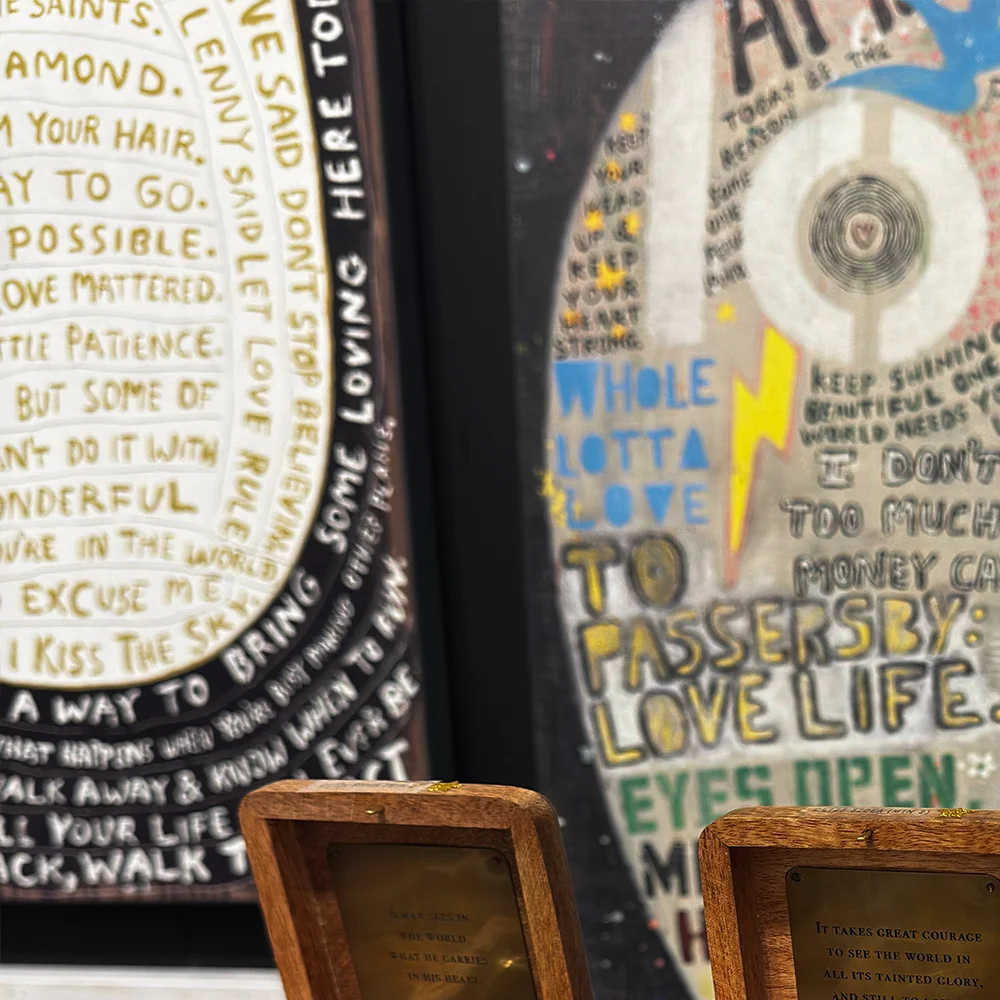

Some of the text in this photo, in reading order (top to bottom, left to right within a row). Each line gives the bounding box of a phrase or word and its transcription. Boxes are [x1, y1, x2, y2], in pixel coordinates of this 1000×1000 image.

[28, 111, 206, 166] YOUR HAIR.
[56, 169, 208, 212] TO GO.
[7, 225, 218, 259] POSSIBLE.
[66, 322, 222, 361] PATIENCE.
[316, 94, 375, 554] SOME LOVING HERE
[15, 380, 220, 422] BUT SOME OF
[554, 357, 717, 420] WHOLE
[66, 435, 219, 468] DO IT WITH
[555, 427, 710, 478] LOTTA
[817, 449, 854, 488] I
[564, 482, 708, 531] LOVE
[779, 498, 864, 538] TOO
[122, 529, 174, 561] THE
[561, 531, 688, 616] TO
[793, 550, 937, 595] MONEY
[21, 575, 222, 618] EXCUSE ME
[9, 566, 322, 726] A WAY TO BRING
[9, 633, 174, 676] I KISS THE
[577, 592, 988, 696] PASSERSBY:
[592, 667, 779, 767] LOVE
[48, 806, 232, 846] YOUR LIFE
[88, 845, 211, 887] WALK
[401, 932, 466, 943] THE WORLD
[457, 914, 468, 922] IN
[833, 926, 872, 936] TAKES
[877, 928, 918, 939] GREAT
[922, 931, 982, 942] COURAGE
[425, 954, 439, 962] HE
[443, 955, 488, 965] CARRIES
[827, 948, 970, 964] TO SEE THE WORLD IN
[424, 974, 441, 982] HIS
[825, 970, 984, 989] ALL ITS TAINTED GLORY,
